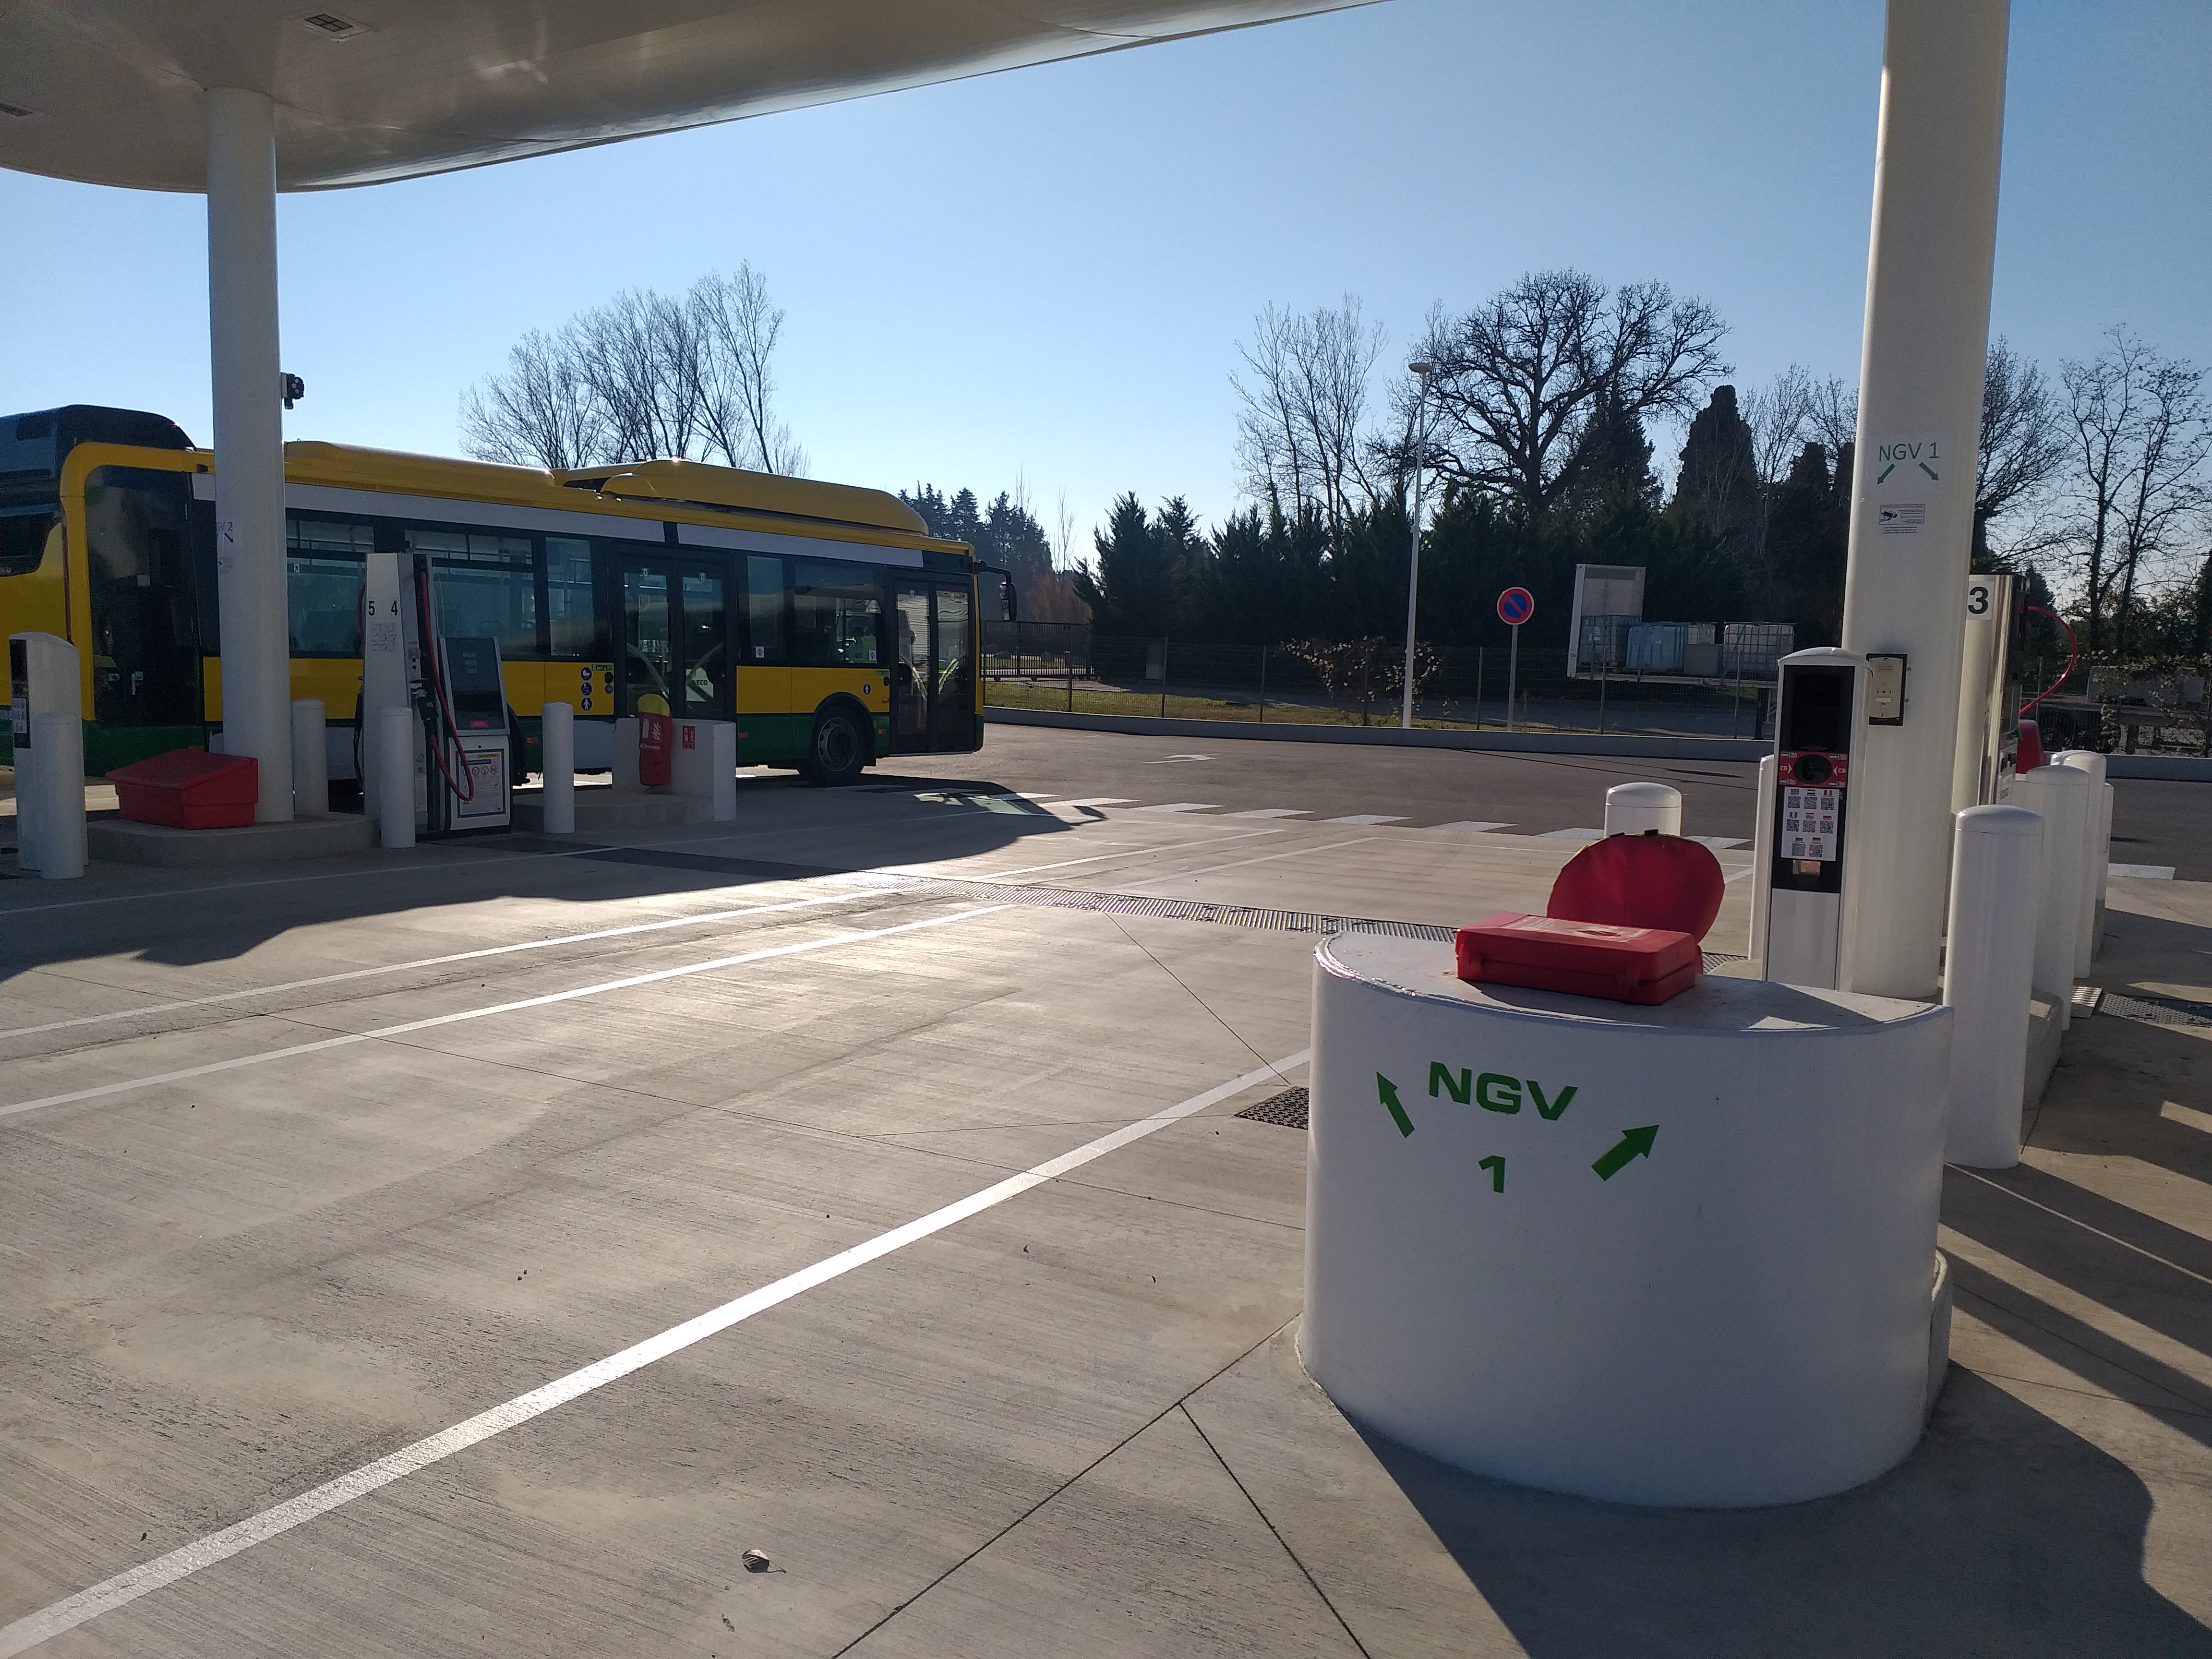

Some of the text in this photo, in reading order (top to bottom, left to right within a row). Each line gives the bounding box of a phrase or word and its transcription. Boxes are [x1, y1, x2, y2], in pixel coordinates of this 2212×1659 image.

[1879, 442, 1939, 462] NGV 1
[228, 522, 233, 531] 2
[369, 601, 398, 615] 5 4
[1968, 587, 1989, 614] 3
[1428, 1061, 1578, 1121] NGV
[1478, 1155, 1505, 1192] 1
